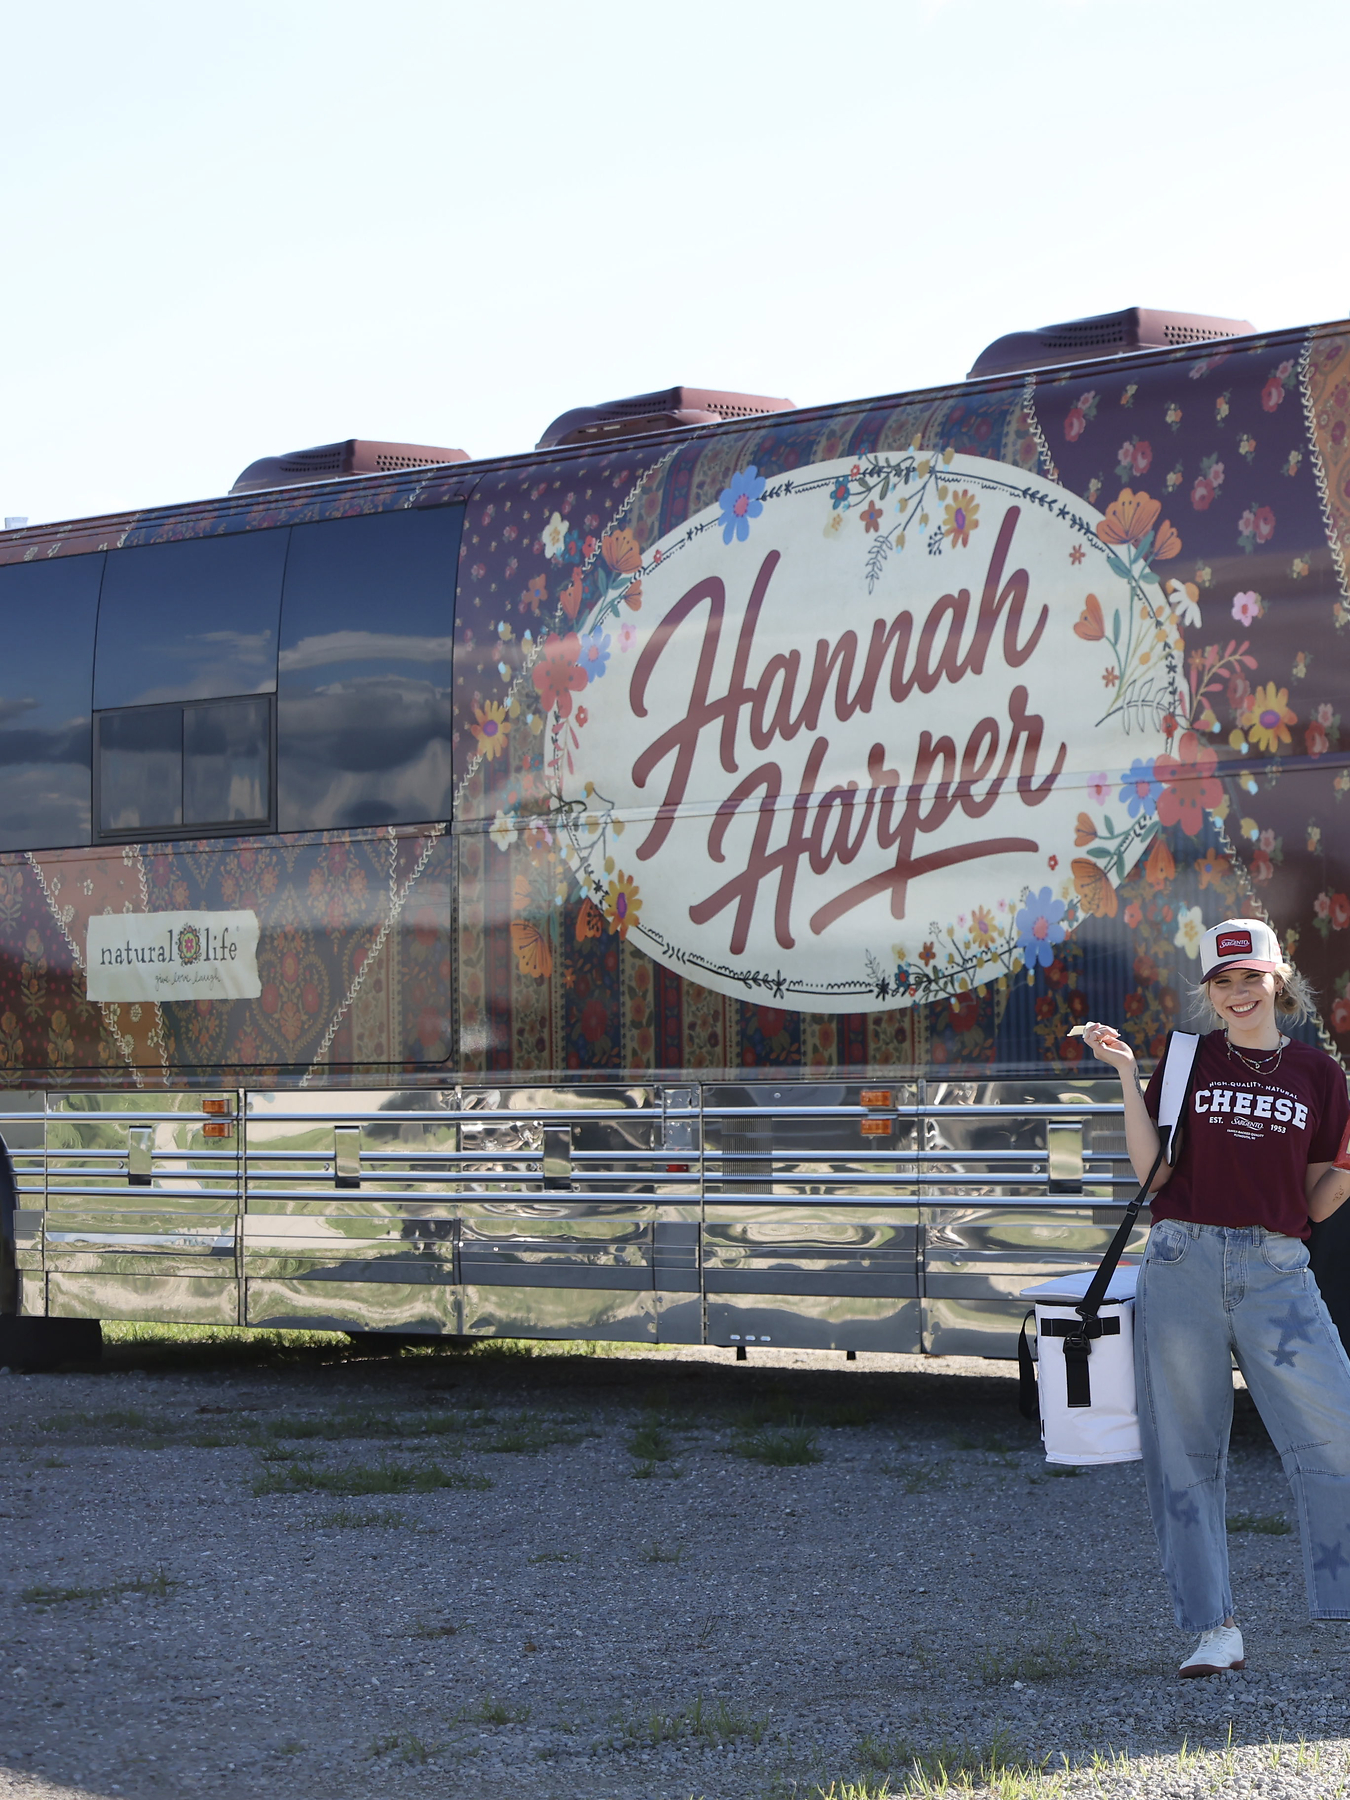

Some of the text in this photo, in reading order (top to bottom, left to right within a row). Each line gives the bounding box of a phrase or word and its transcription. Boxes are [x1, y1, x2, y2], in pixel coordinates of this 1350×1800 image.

[629, 506, 1049, 861] Hannah
[689, 685, 1067, 954] Harper
[100, 927, 238, 965] natural life
[1219, 938, 1250, 949] SARGENTO
[1195, 1089, 1308, 1130] CHEESE
[1266, 1085, 1298, 1100] NATURAL
[1209, 1116, 1224, 1124] EST.
[1270, 1124, 1287, 1134] 1953
